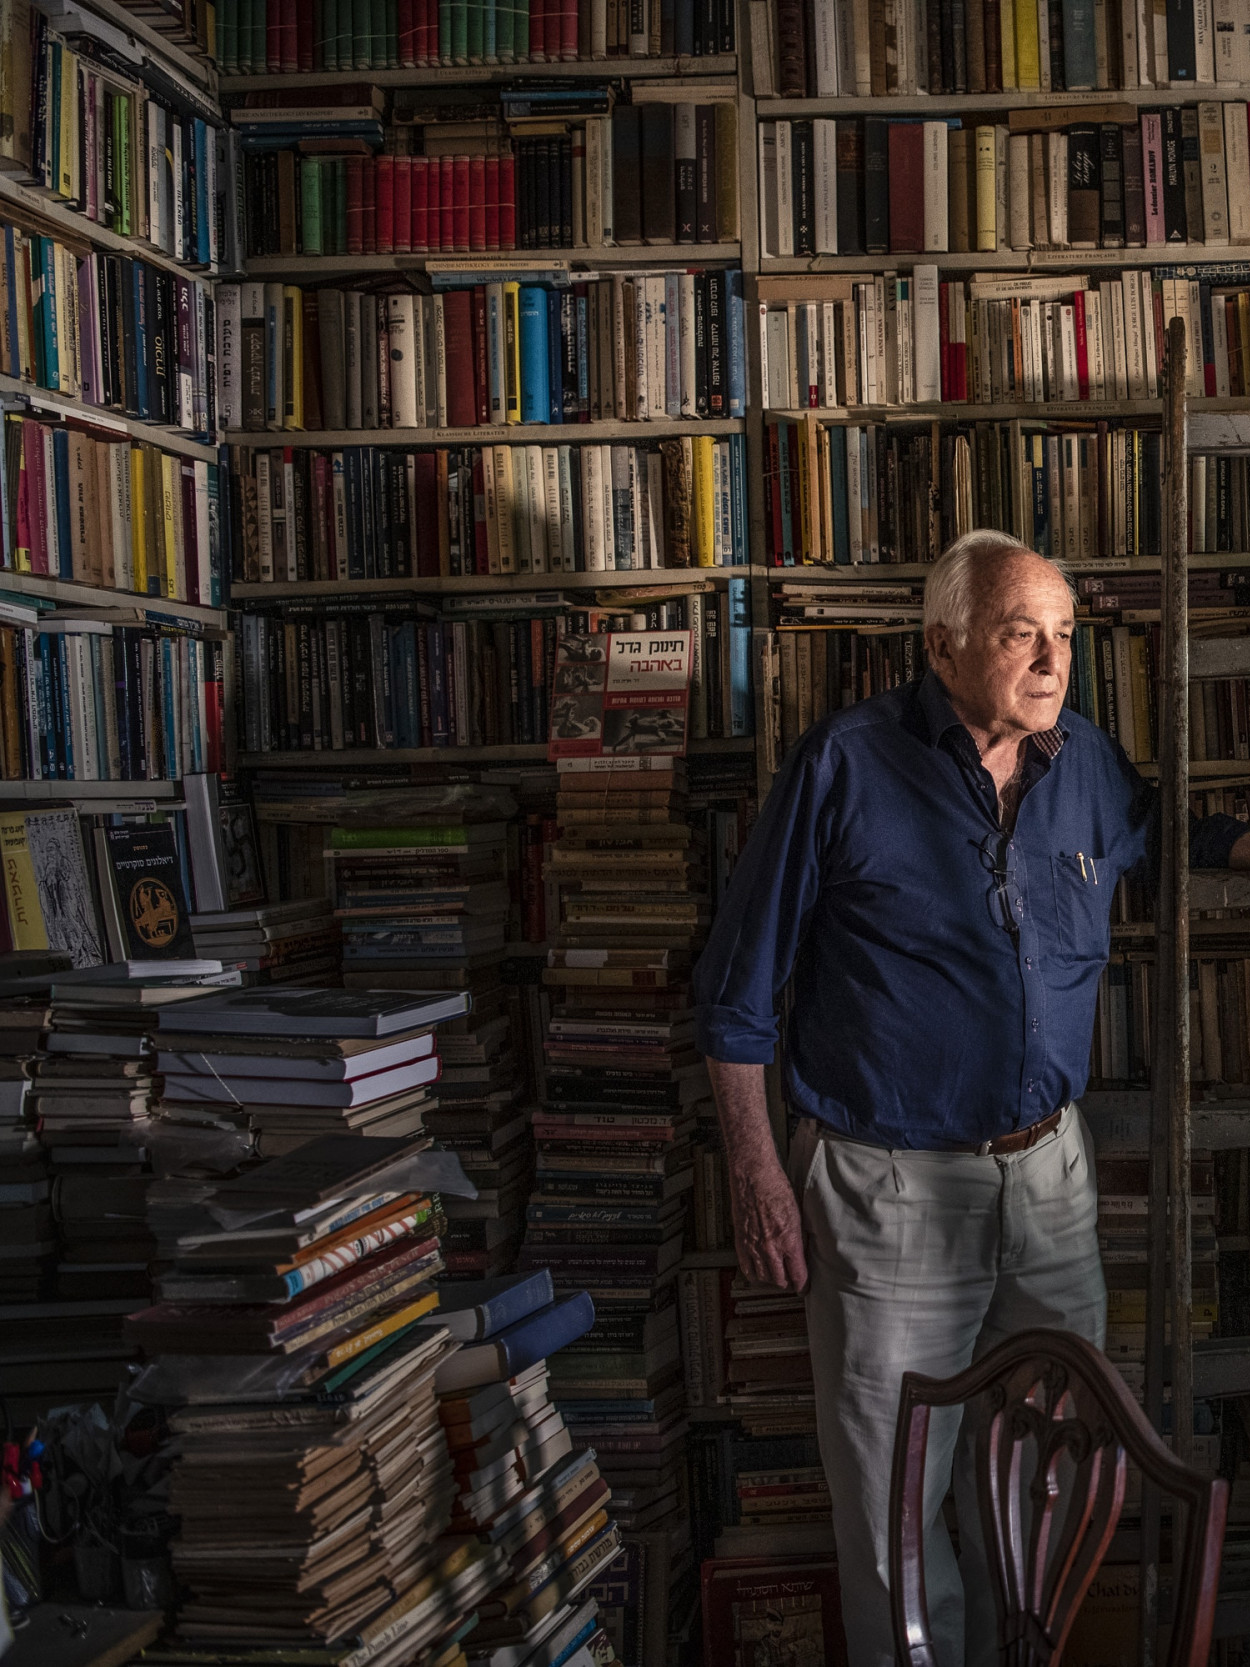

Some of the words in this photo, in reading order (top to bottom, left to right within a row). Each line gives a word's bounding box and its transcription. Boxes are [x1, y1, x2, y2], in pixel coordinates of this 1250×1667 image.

[1148, 149, 1157, 183] ROMANOV
[1149, 184, 1158, 207] dossier
[888, 276, 897, 312] KAFKA
[1128, 273, 1136, 296] BORGES
[1130, 310, 1138, 329] JORGE
[615, 640, 641, 655] גדל
[648, 639, 685, 655] תינוק
[630, 658, 683, 673] באהבה
